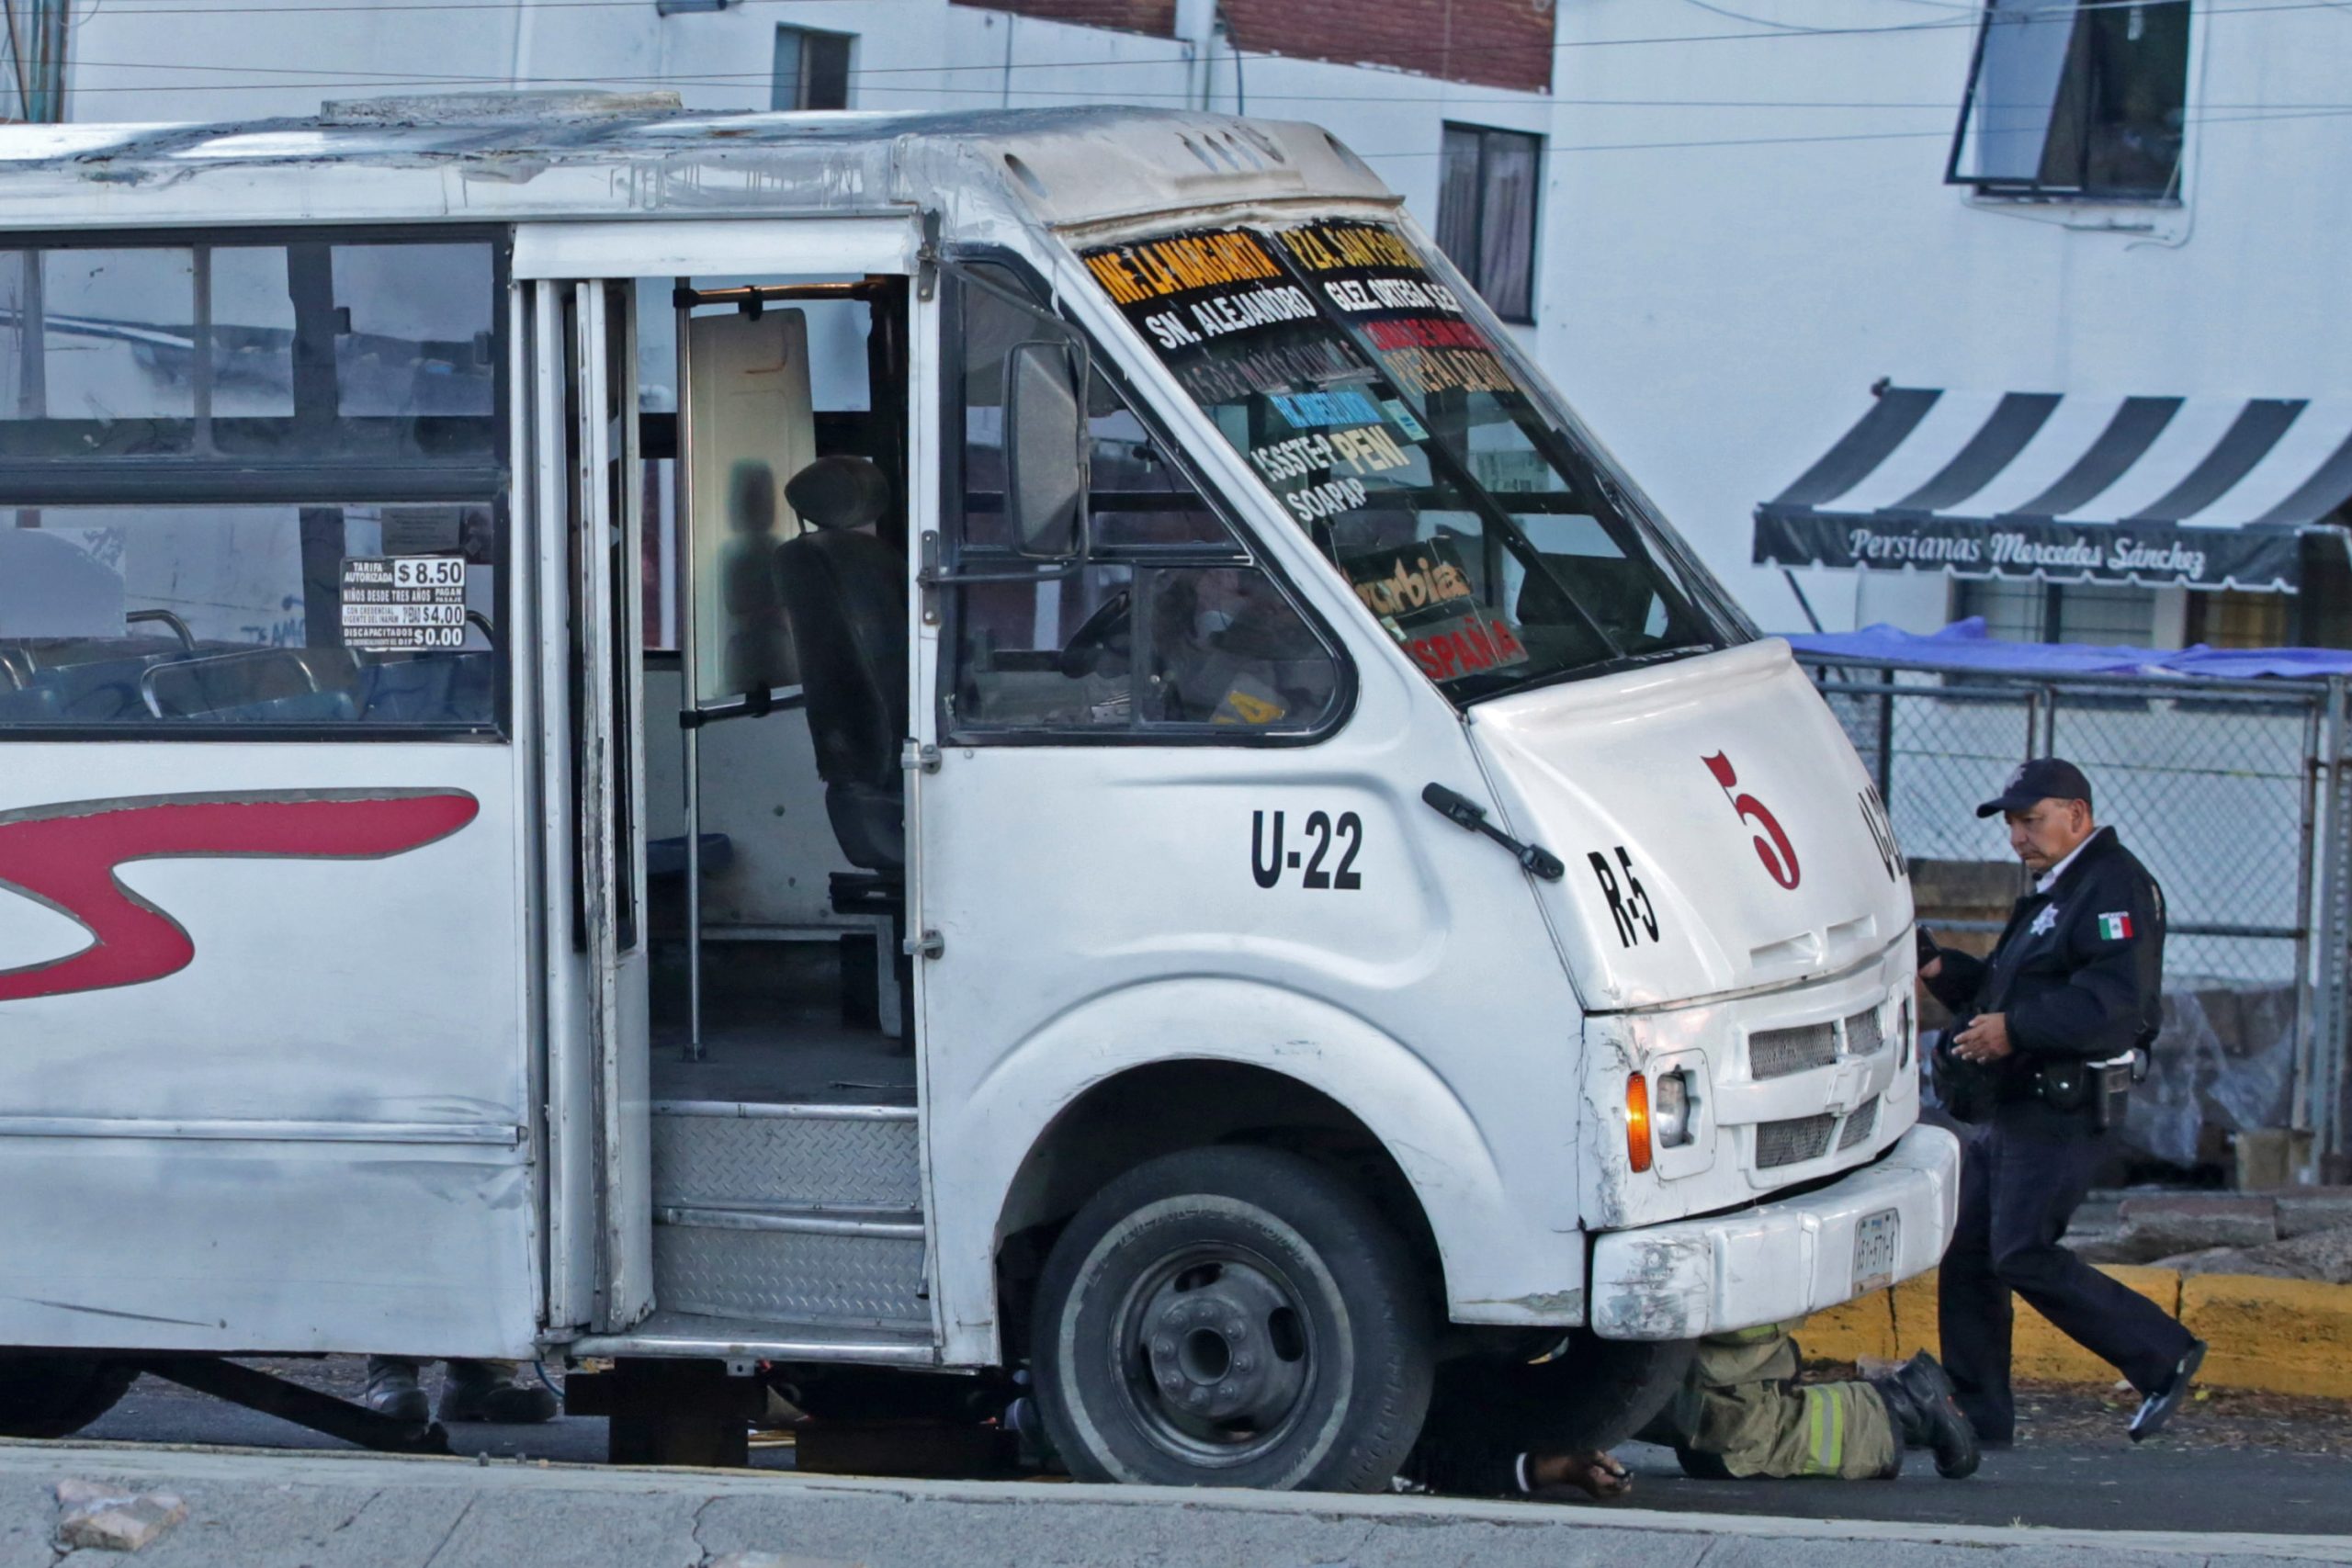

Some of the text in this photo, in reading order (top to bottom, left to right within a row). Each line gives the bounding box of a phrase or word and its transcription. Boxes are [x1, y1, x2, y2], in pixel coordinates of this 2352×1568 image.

[1085, 231, 1282, 304] INF. LA MARGARITA
[1367, 278, 1435, 309] ORTEGA
[1145, 310, 1202, 350] SN.
[1190, 285, 1317, 338] ALEJANDRO
[1329, 425, 1410, 476] PENI
[1286, 477, 1367, 522] SOAPAP
[353, 562, 383, 572] TARIFA
[1849, 528, 2205, 581] Persianas Mercedes Sánchez
[343, 587, 431, 603] NIÑOS DESDE TRES AÑOS
[344, 572, 393, 583] AUTORIZADA
[435, 588, 462, 596] PAGAN
[344, 628, 413, 637] DISCAPACITADOS
[414, 627, 463, 647] $0.00
[424, 606, 463, 625] $4.00
[1402, 616, 1523, 681] SPAÑA
[1700, 749, 1801, 890] 5
[1251, 810, 1363, 890] U-22
[1587, 846, 1659, 948] R-5
